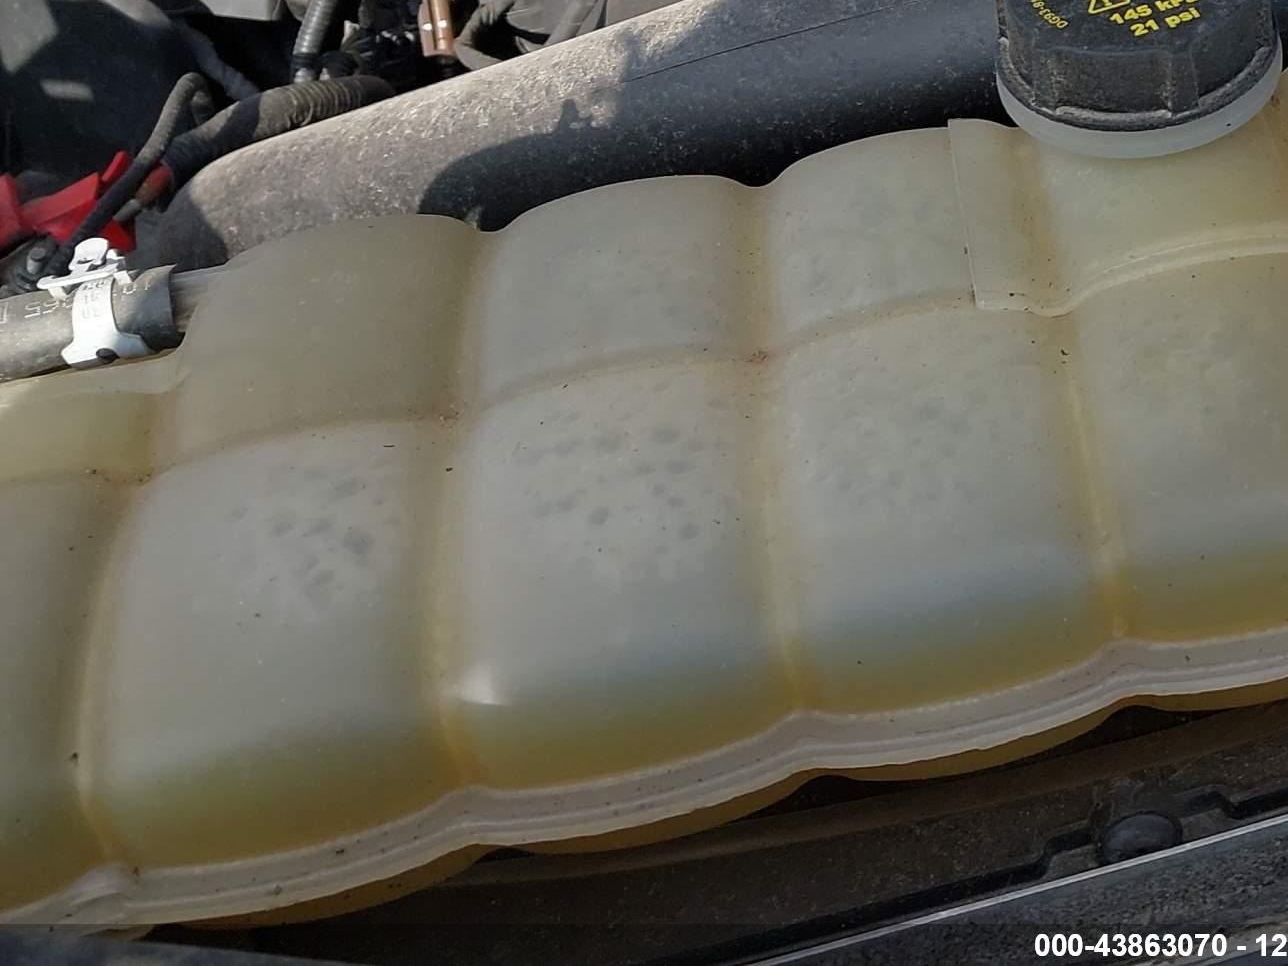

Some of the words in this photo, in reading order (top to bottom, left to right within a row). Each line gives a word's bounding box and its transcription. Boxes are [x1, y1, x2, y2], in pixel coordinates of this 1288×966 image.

[1109, 4, 1153, 25] 145
[1130, 18, 1160, 37] 21
[1163, 7, 1201, 28] psi
